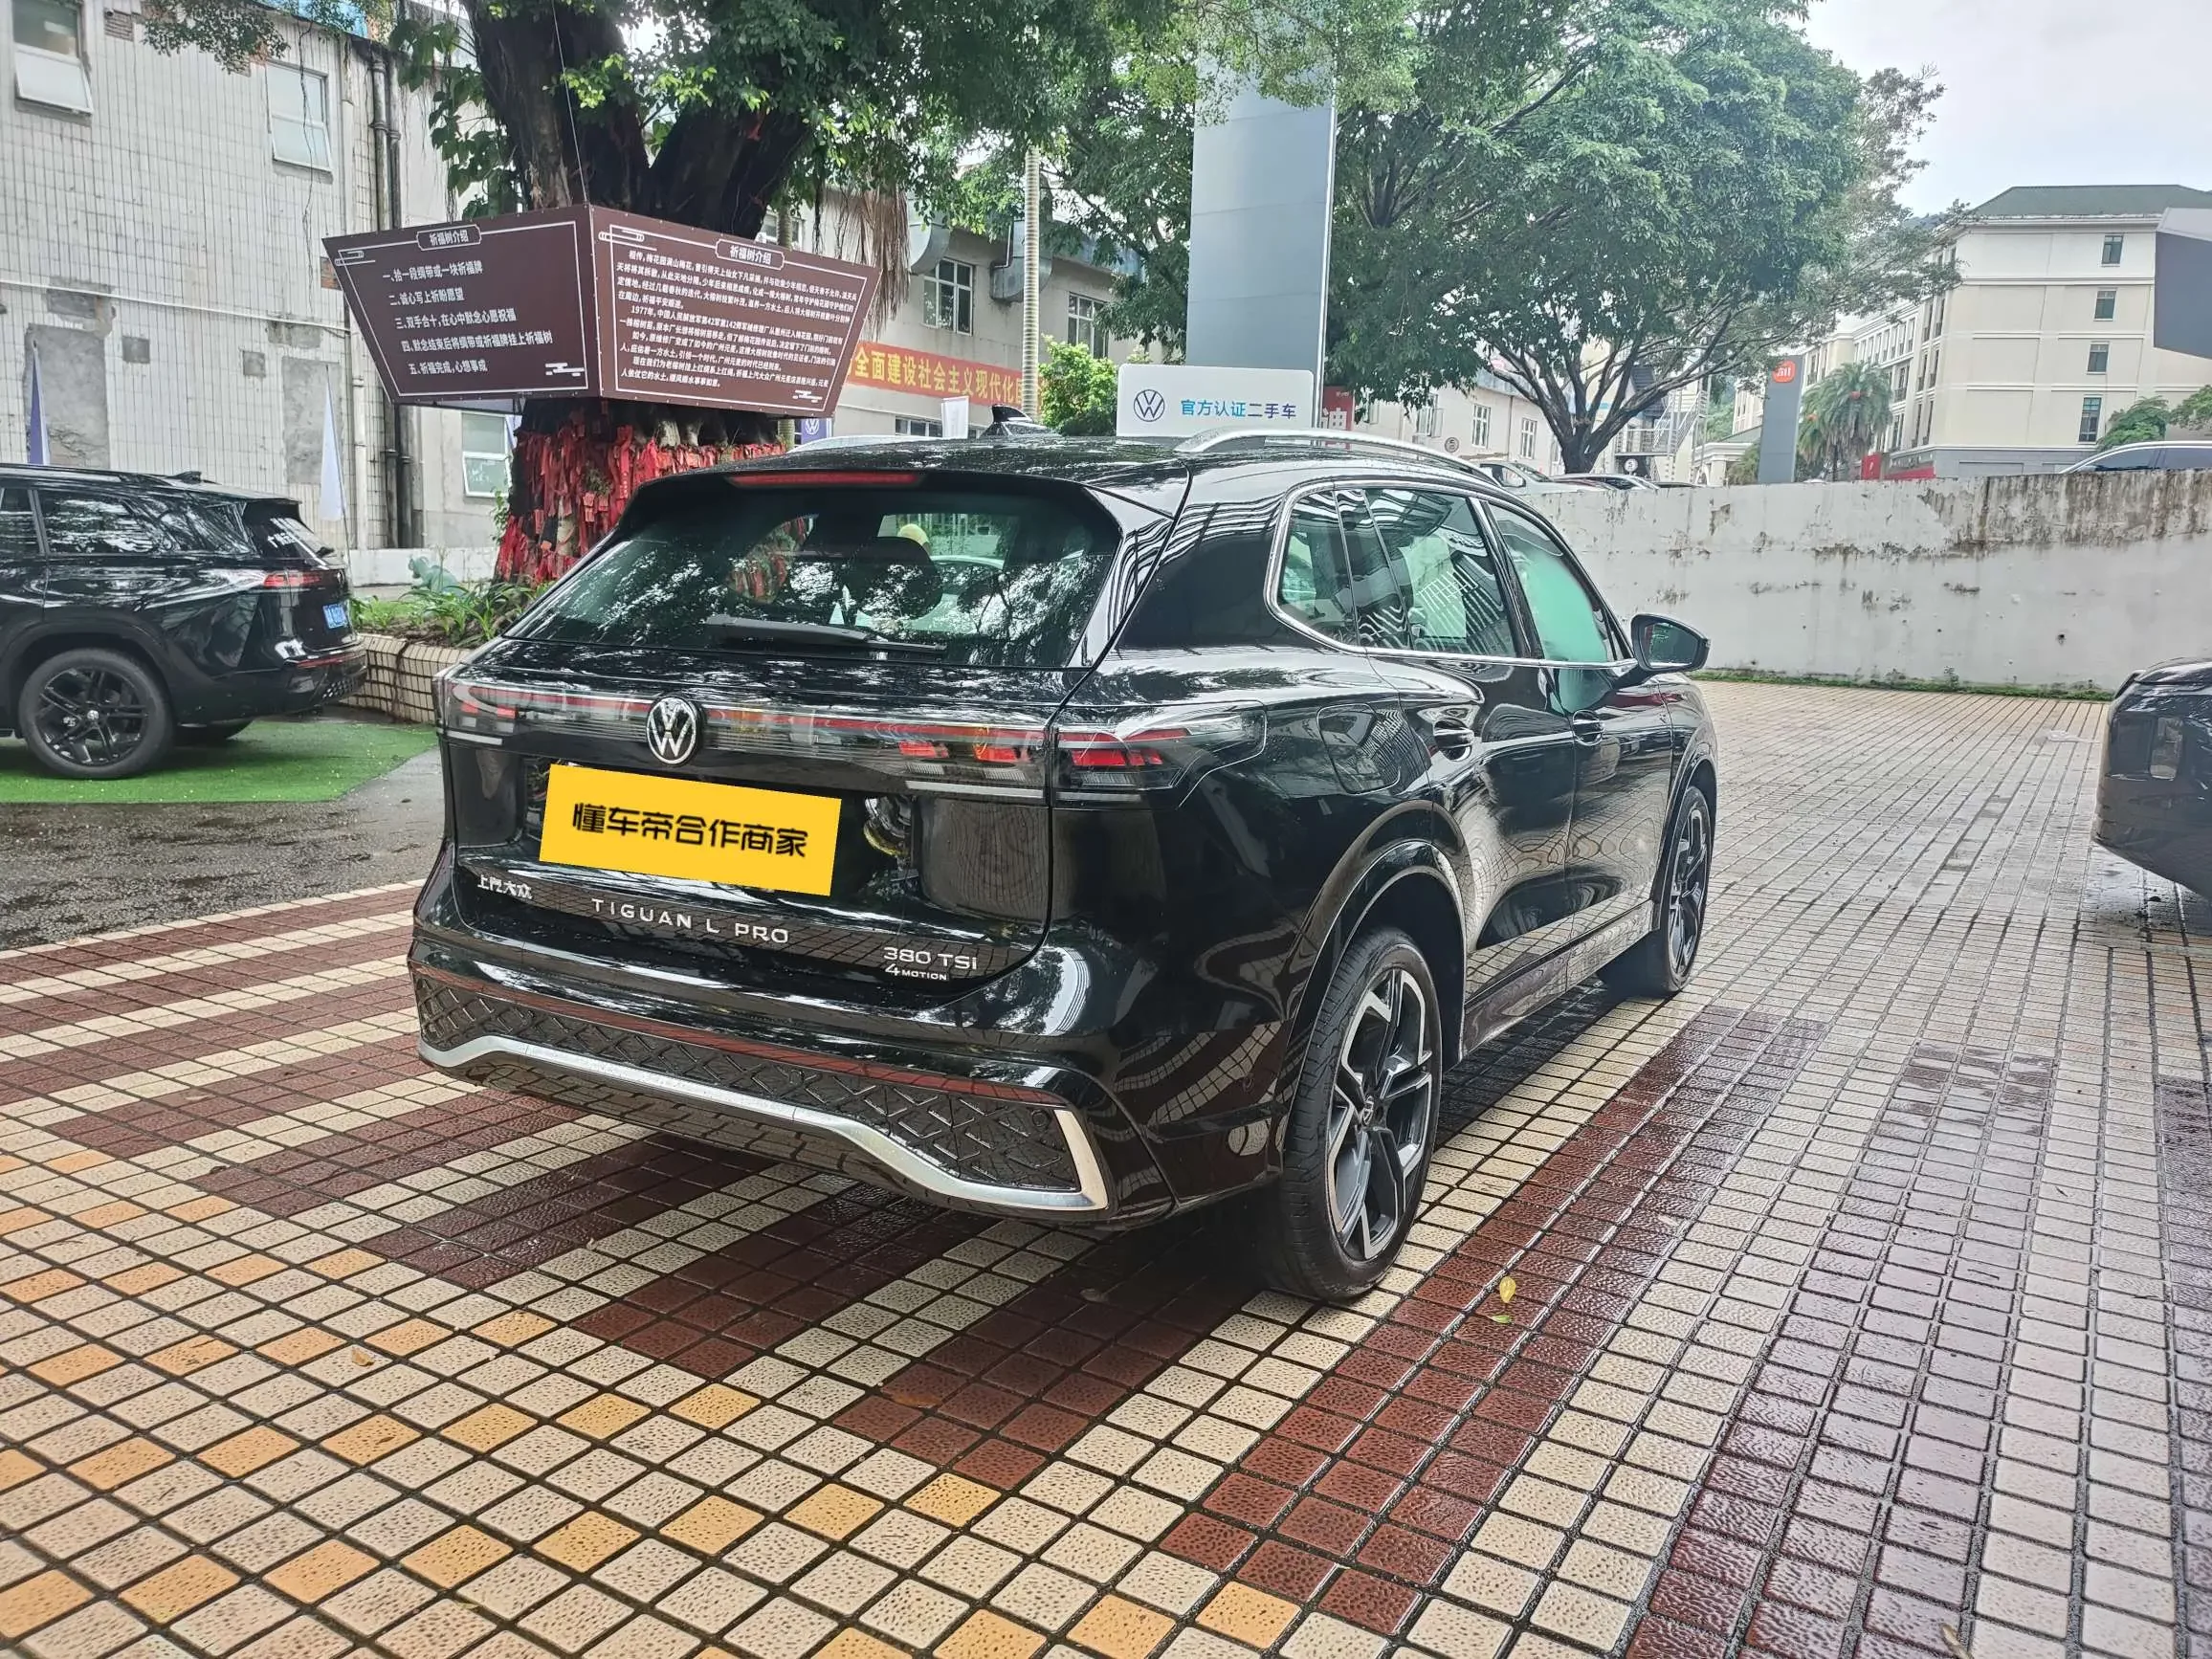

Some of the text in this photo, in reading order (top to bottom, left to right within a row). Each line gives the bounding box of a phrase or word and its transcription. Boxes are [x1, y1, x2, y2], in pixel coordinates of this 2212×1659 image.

[430, 230, 469, 246] 祈福树介绍
[730, 245, 772, 266] 祈福树介绍
[1181, 399, 1296, 419] 官方认证二手车
[477, 874, 533, 900] 上汽大众
[591, 897, 789, 944] TIGUAN L PRO
[883, 946, 932, 965] 380
[884, 963, 948, 981] 4MOTION
